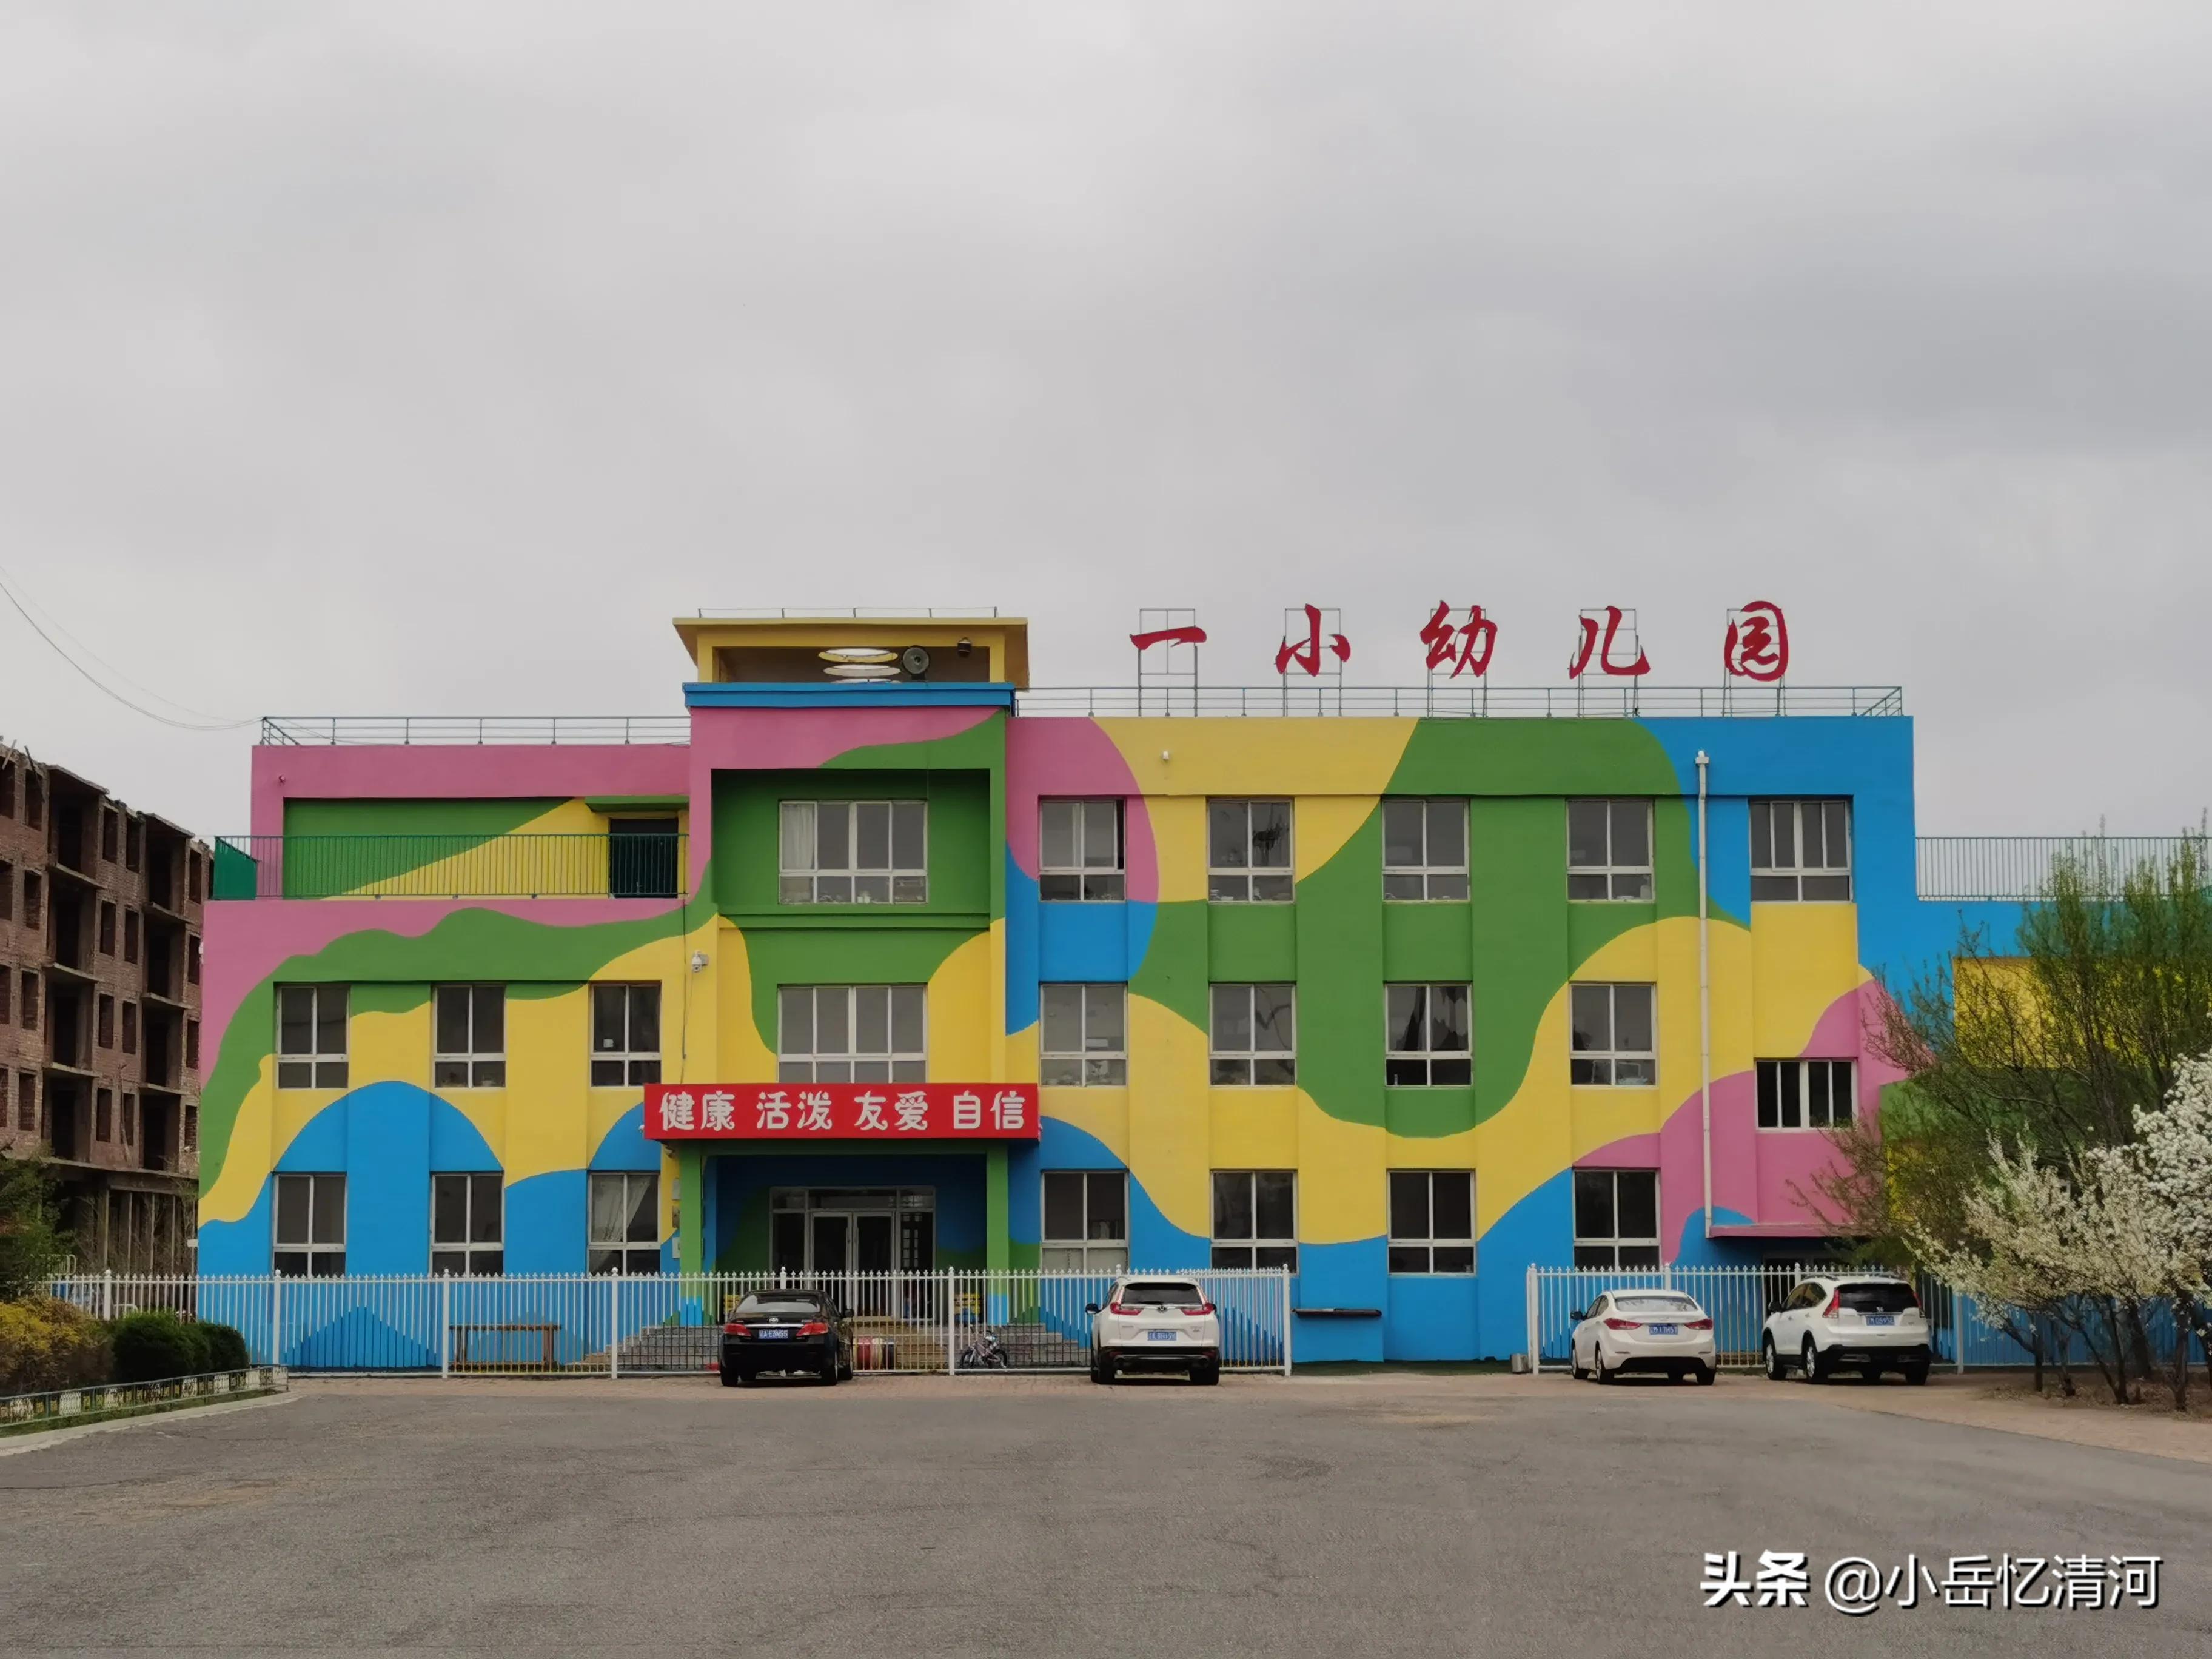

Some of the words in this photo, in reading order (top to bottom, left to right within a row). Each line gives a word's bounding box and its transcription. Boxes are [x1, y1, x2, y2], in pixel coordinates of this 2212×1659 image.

[1130, 600, 1789, 682] 一小幼儿园
[659, 1091, 736, 1131] 健康
[756, 1091, 833, 1131] 活泼
[853, 1091, 929, 1131] 友爱
[953, 1091, 1025, 1130] 自信
